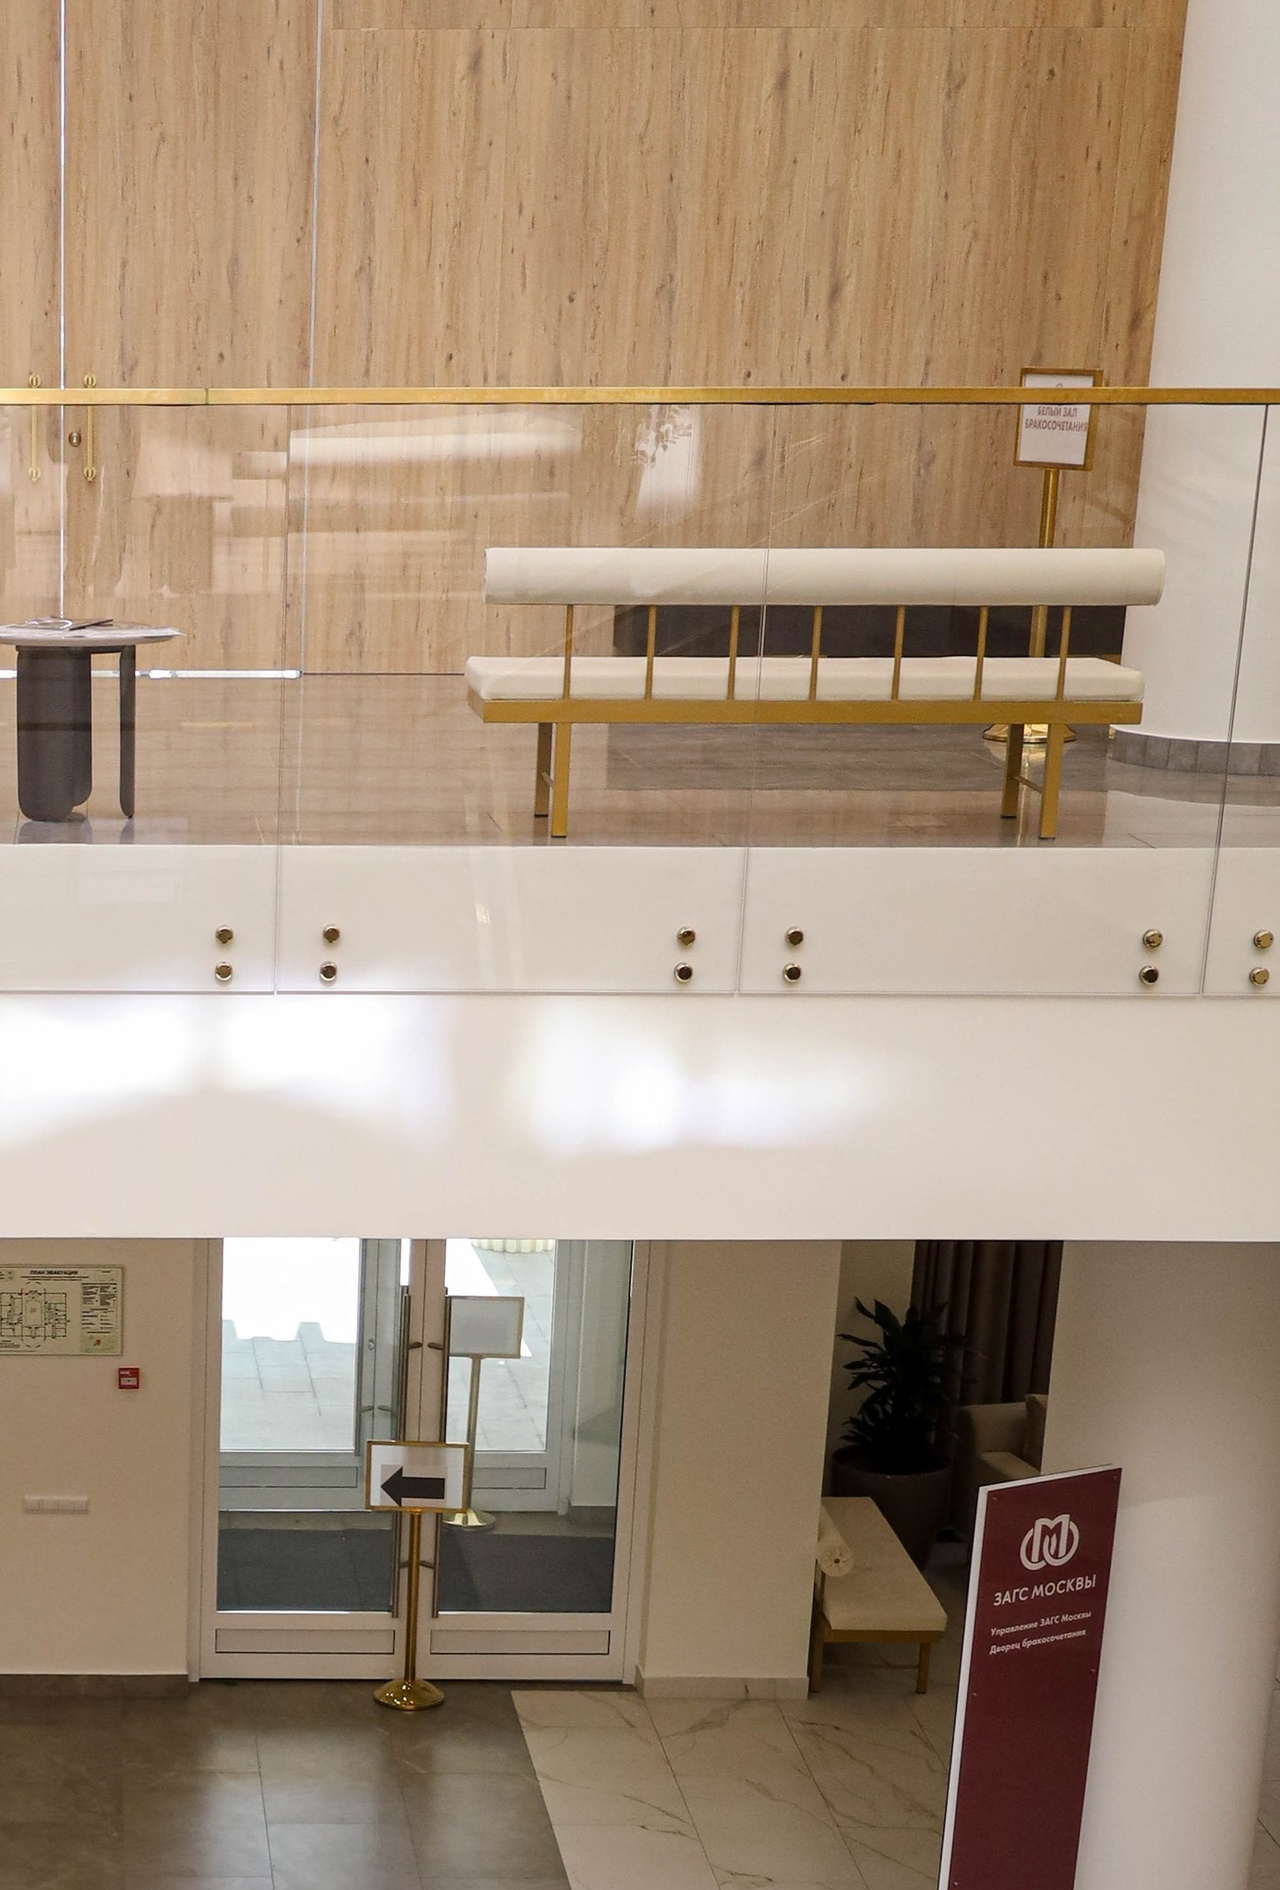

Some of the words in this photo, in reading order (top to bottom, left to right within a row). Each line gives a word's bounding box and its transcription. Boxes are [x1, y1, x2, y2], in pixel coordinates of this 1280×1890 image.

[1062, 406, 1078, 418] ЗАЛ
[1025, 419, 1088, 432] БРАКОСОЧЕТАНИЯ
[993, 1587, 1029, 1606] ЗАГС
[1030, 1574, 1096, 1599] МОСКВЫ
[990, 1621, 1038, 1636] Управление
[1039, 1615, 1060, 1627] ЗАГС
[1060, 1611, 1092, 1623] Москвы
[989, 1643, 1021, 1655] Дворец
[1021, 1629, 1087, 1649] бракосочетания
